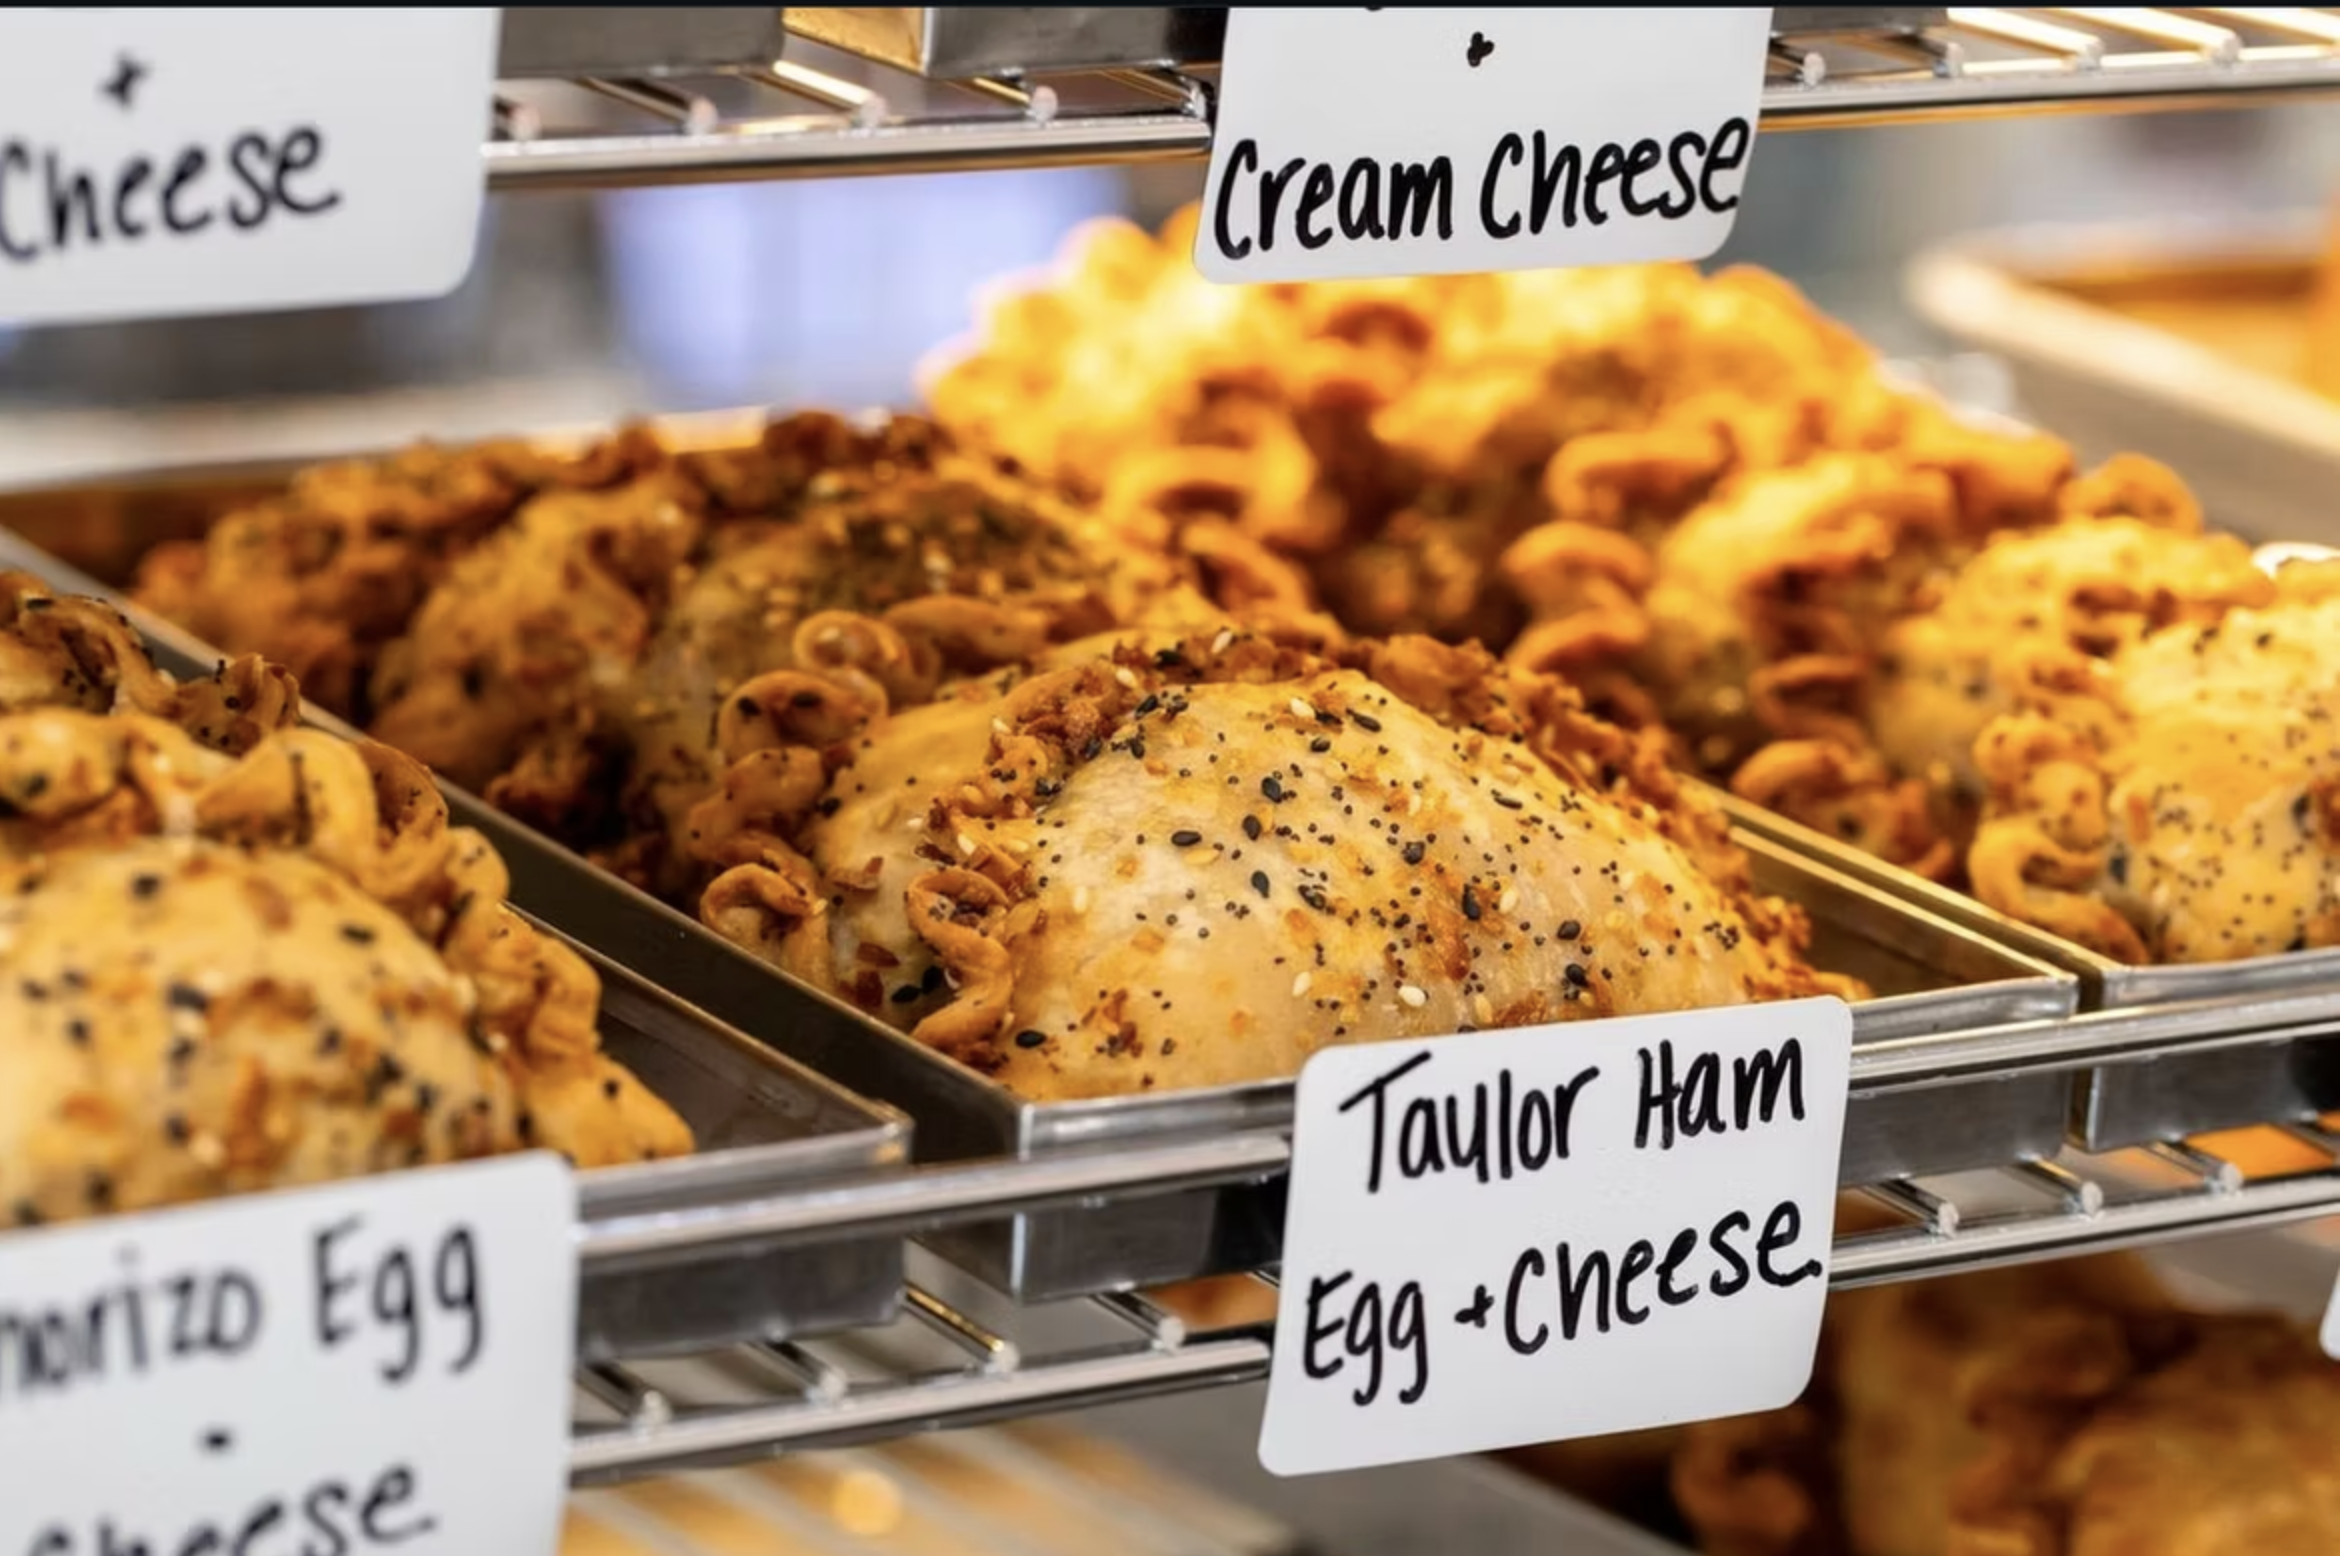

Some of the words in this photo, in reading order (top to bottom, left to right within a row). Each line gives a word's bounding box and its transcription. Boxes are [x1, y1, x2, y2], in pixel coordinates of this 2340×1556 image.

[0, 125, 342, 261] Cheese
[1214, 138, 1453, 260] Cream
[1479, 117, 1751, 239] Cheese
[1338, 1049, 1600, 1194] Taylor
[1634, 1037, 1806, 1150] Ham
[313, 1212, 484, 1385] Egg
[1303, 1270, 1430, 1407] Egg
